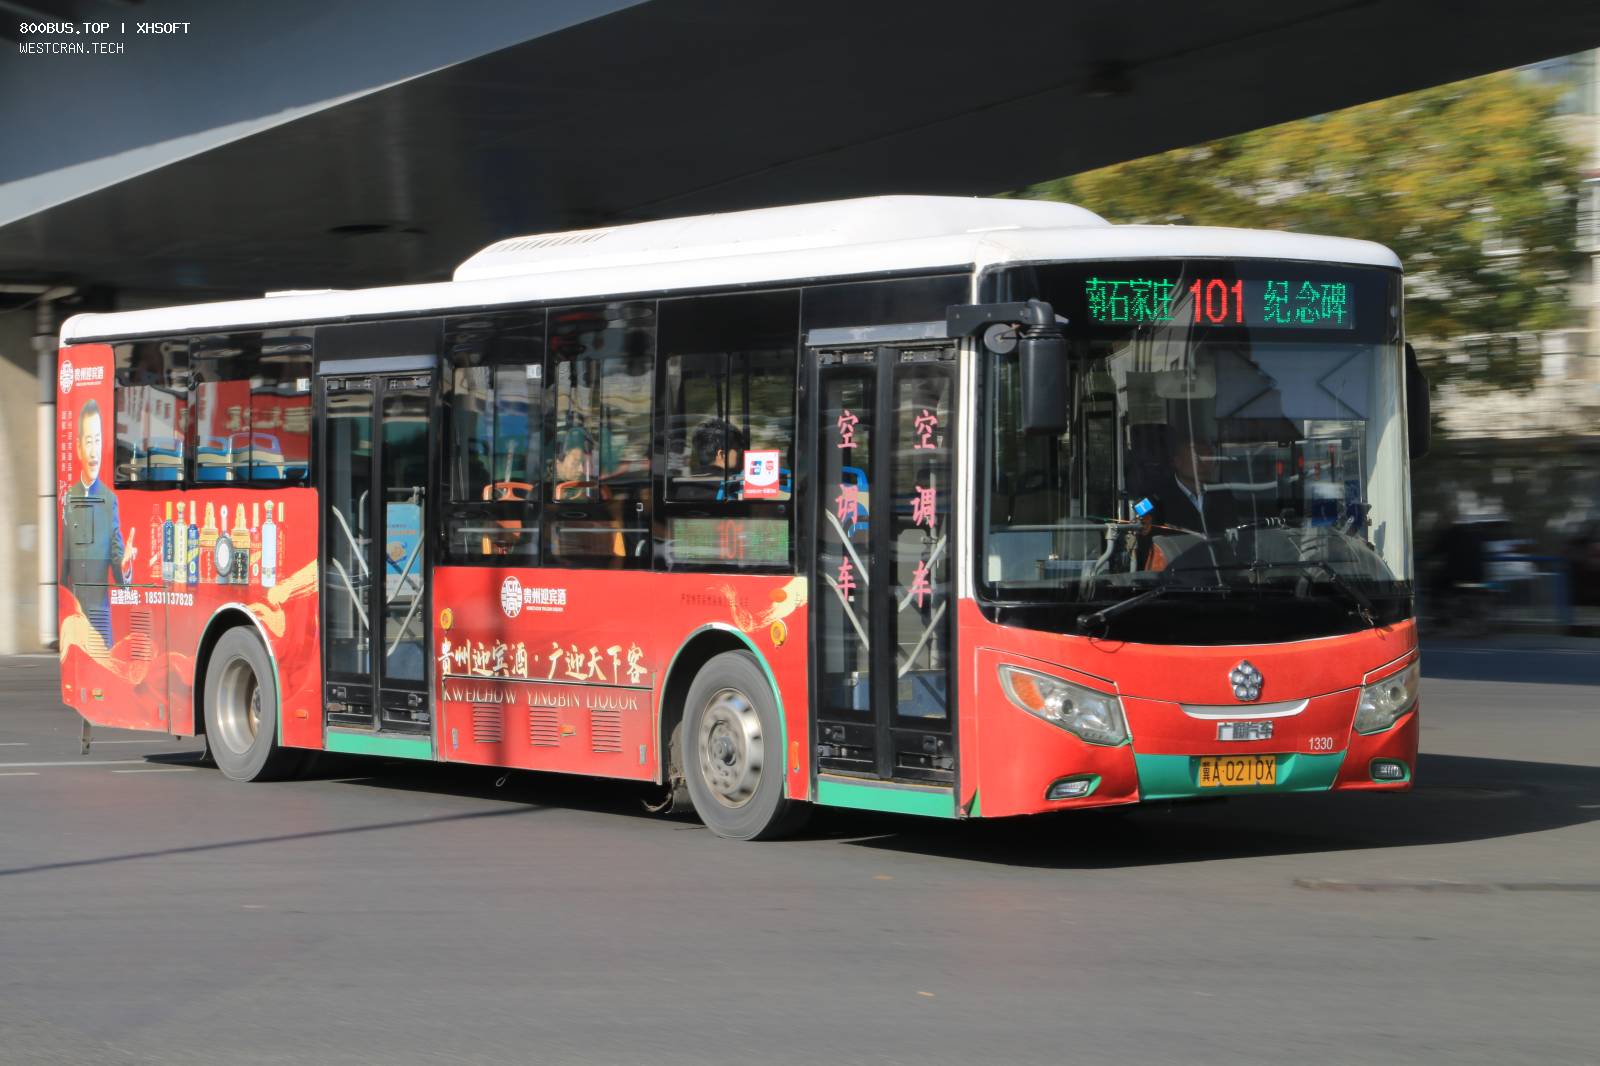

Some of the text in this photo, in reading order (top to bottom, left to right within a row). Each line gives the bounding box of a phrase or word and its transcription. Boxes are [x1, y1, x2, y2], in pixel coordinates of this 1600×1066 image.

[1190, 278, 1243, 323] 101
[1264, 280, 1347, 323] 纪念碑
[836, 409, 859, 602] 空调车
[910, 409, 937, 608] 空调车
[144, 591, 194, 606] 18531137828
[523, 587, 567, 606] 贵州迎宾酒
[527, 691, 580, 708] YINGBIN
[586, 694, 638, 711] LIQUOR
[1308, 736, 1333, 750] 1330
